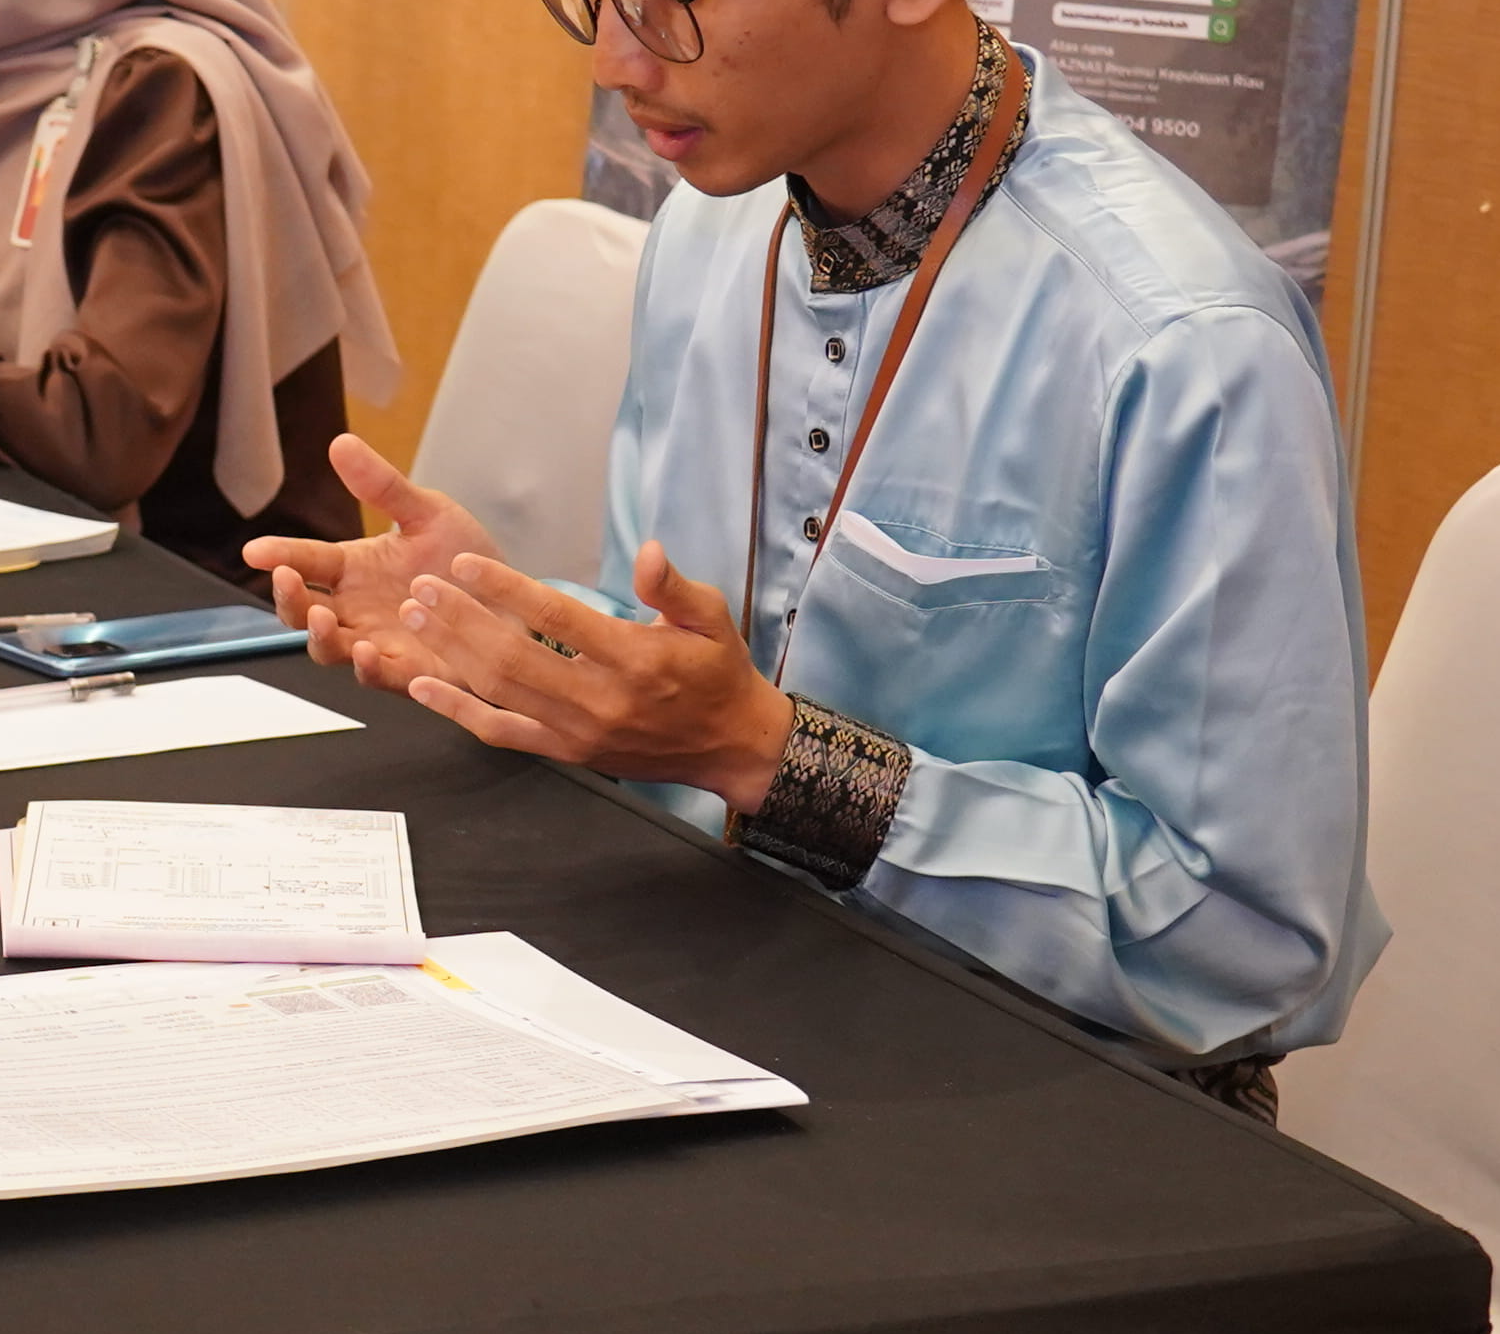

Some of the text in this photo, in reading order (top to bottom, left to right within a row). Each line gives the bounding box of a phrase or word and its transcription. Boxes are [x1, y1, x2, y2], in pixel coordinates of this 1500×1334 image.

[1160, 68, 1230, 87] Kepulauan
[1233, 73, 1264, 90] Riau
[1152, 119, 1200, 138] 9500
